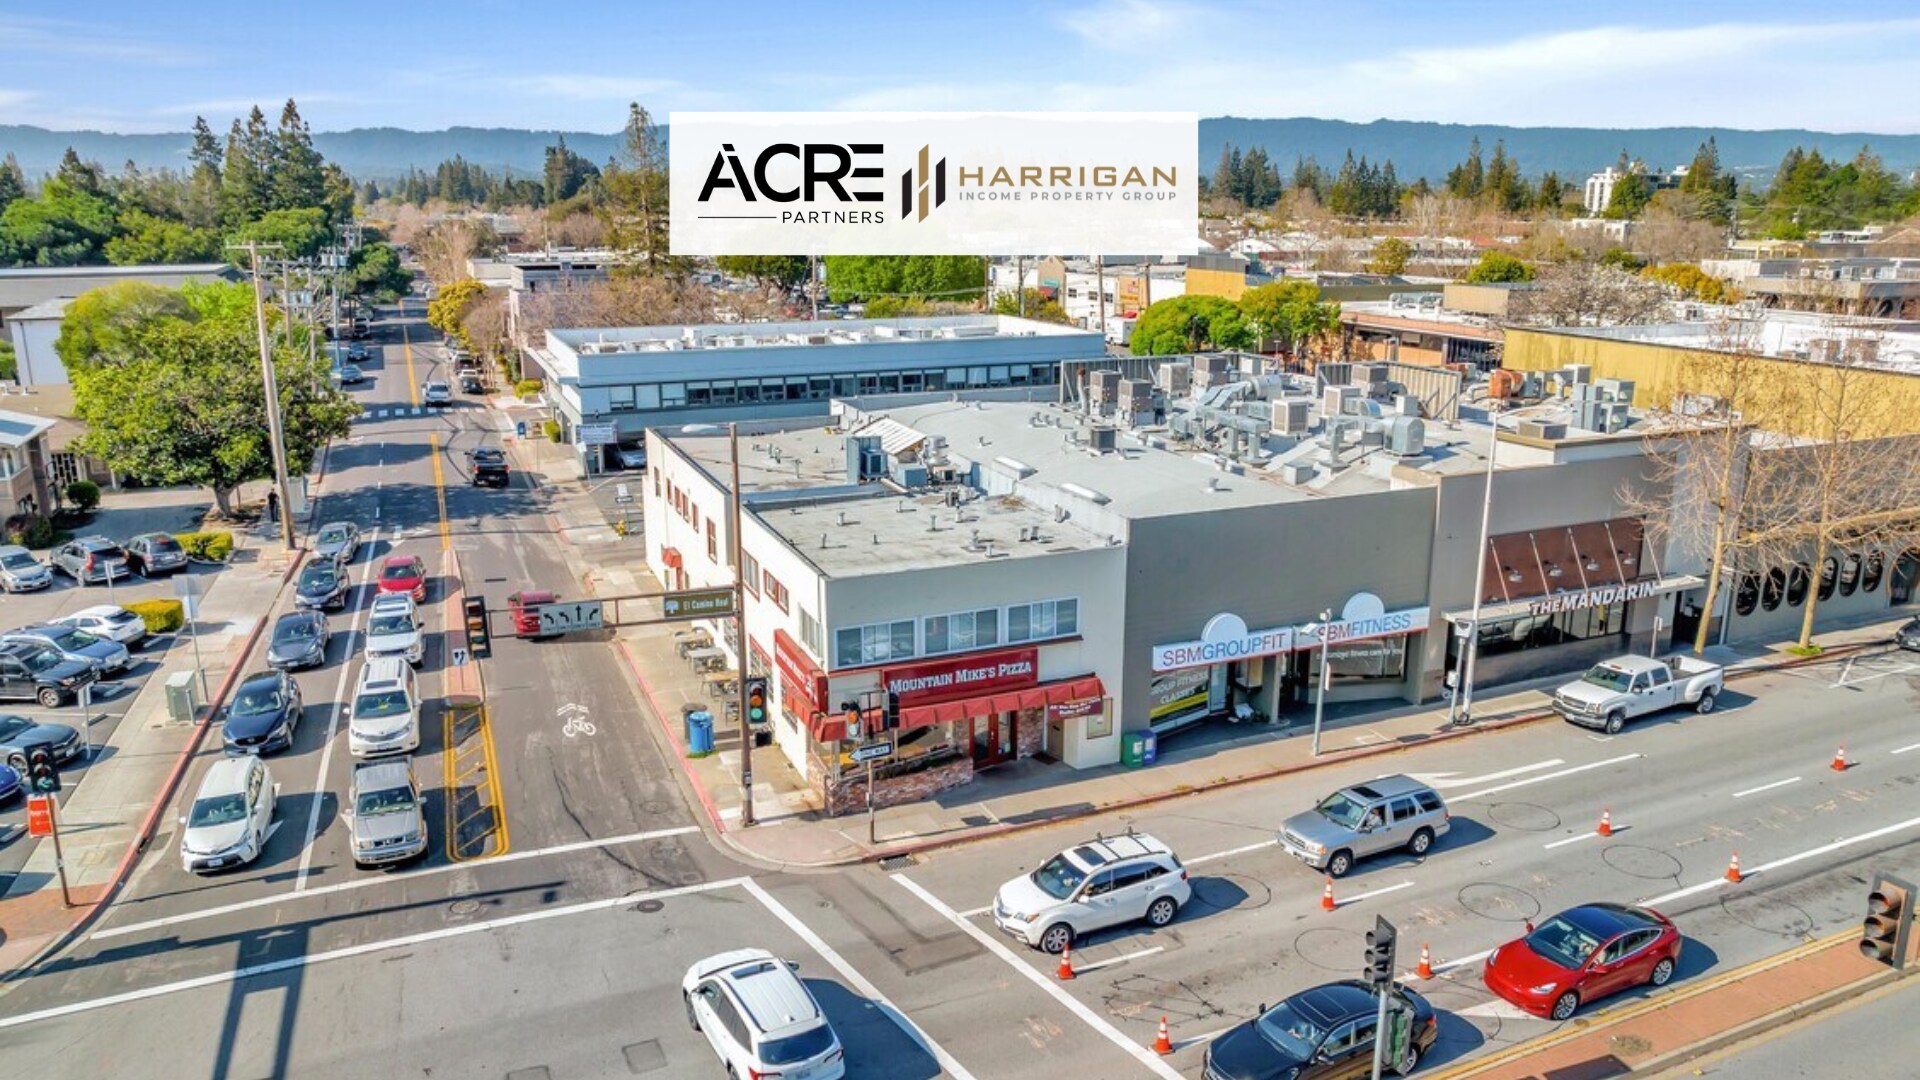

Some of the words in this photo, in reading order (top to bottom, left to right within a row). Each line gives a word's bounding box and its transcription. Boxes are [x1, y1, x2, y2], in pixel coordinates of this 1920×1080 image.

[682, 600, 691, 610] El
[691, 599, 713, 609] Camino
[715, 597, 729, 607] Real
[1527, 599, 1560, 616] THE
[1560, 581, 1656, 612] MANDARIN
[889, 673, 953, 693] MOUNTAIN
[955, 666, 996, 684] MIKE'S
[998, 661, 1032, 677] PIZZA
